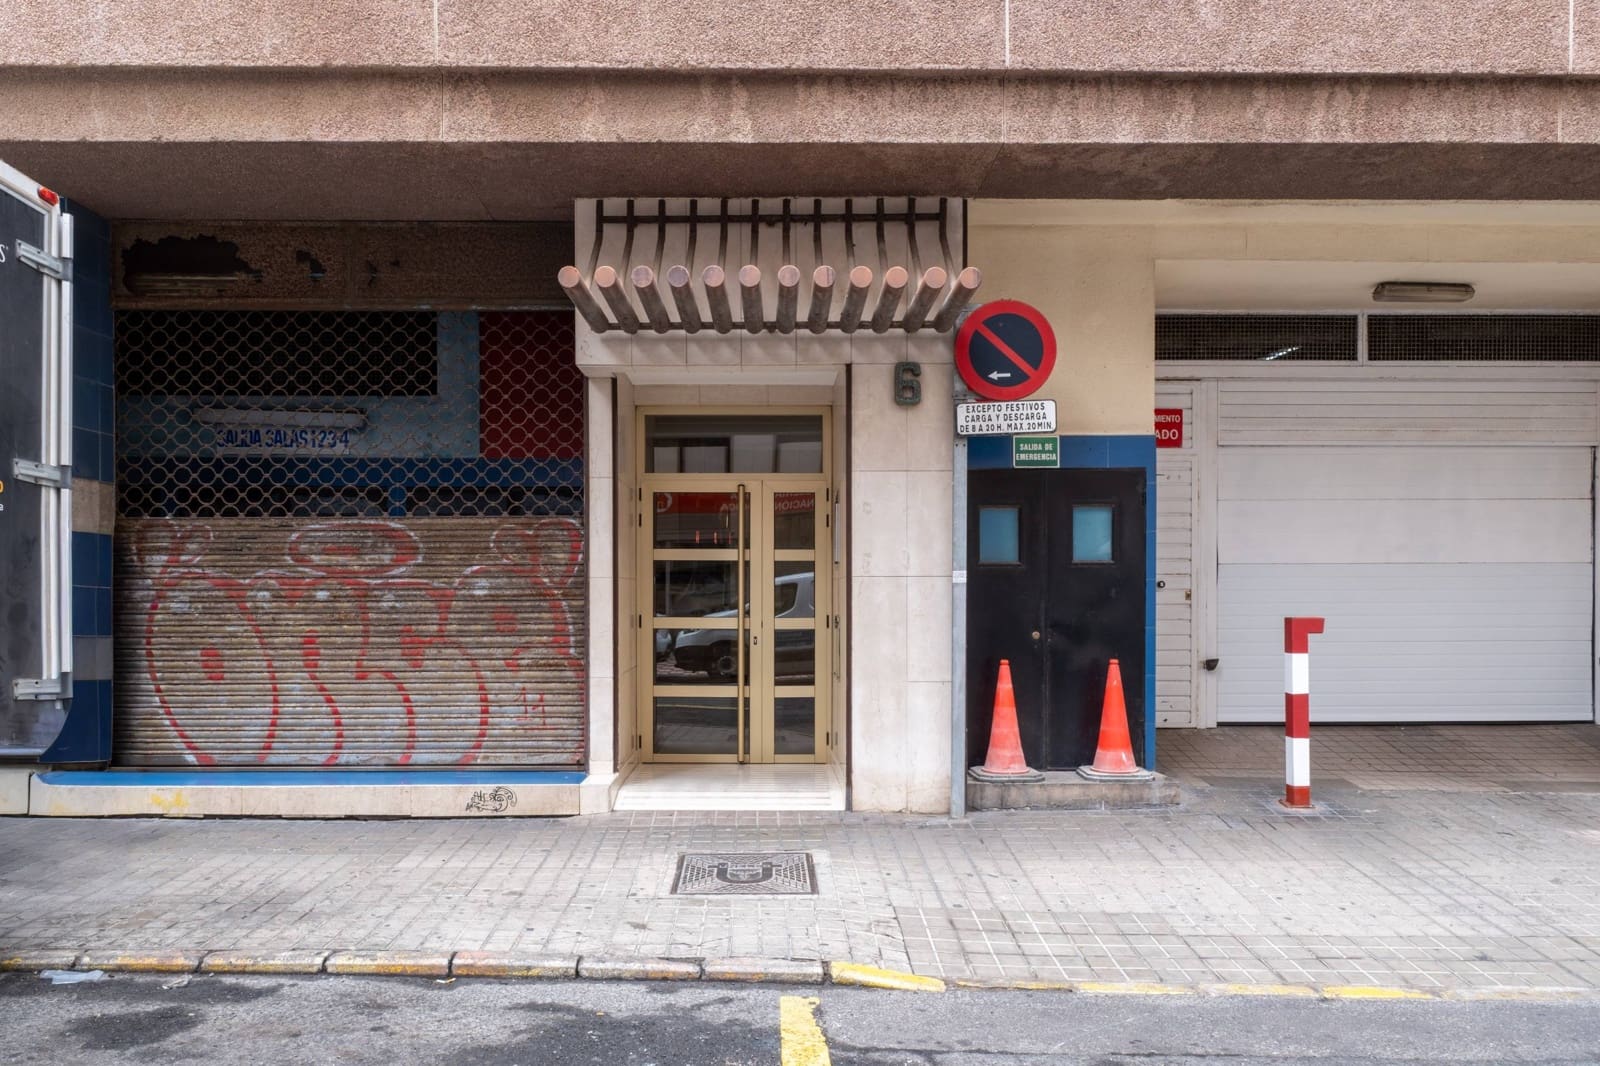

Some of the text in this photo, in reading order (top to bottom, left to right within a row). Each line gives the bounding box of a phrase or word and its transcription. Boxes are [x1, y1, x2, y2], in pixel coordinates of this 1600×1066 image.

[894, 361, 922, 407] 6
[966, 402, 1045, 413] EXCEPTO FESTIVOS
[965, 412, 1047, 423] CARGA Y DESCARGA
[960, 425, 970, 433] DE
[978, 424, 984, 432] A
[986, 424, 995, 432] 20
[1155, 429, 1179, 440] ADO
[1020, 443, 1053, 451] SALIDA DE
[1015, 453, 1057, 461] EMERGENCIA
